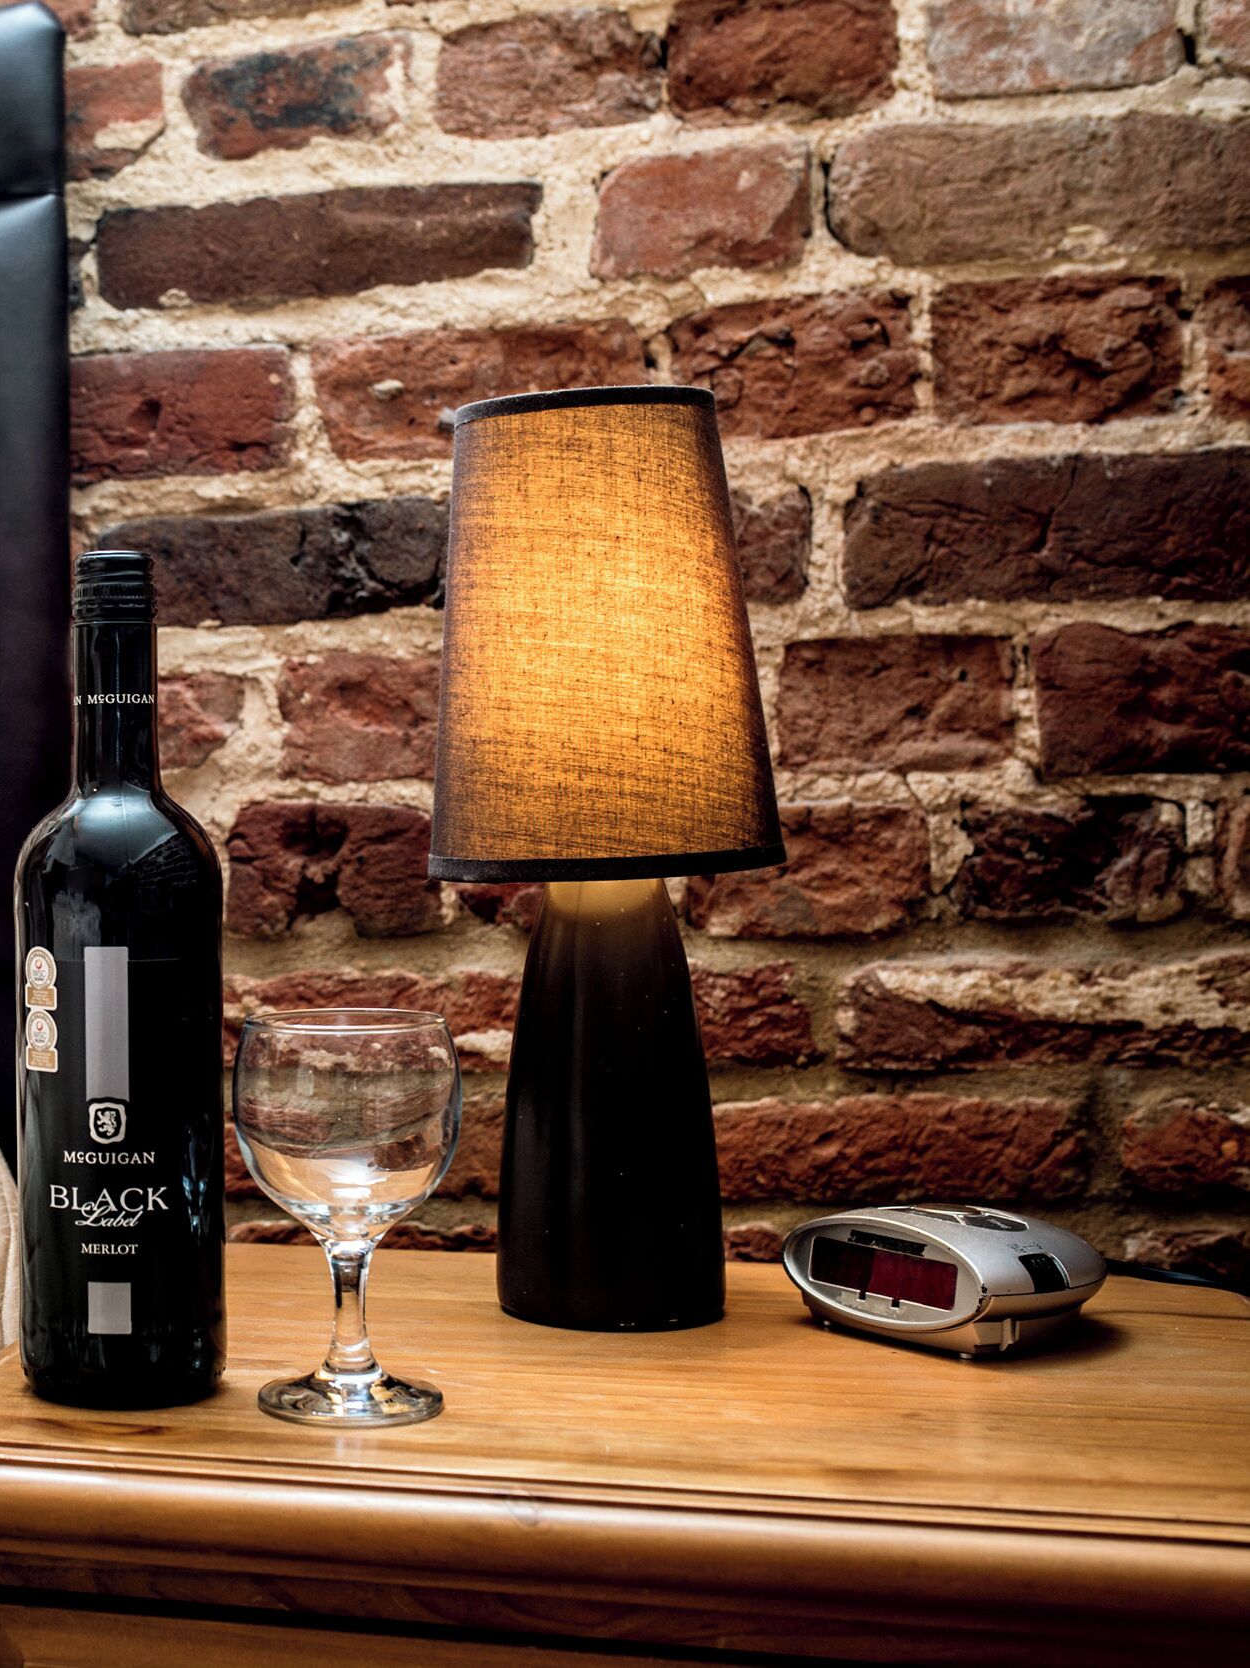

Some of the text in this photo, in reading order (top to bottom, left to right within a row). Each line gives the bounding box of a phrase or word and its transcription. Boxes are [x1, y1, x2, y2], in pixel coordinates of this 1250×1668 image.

[87, 693, 155, 705] McGUIGAN
[63, 1150, 156, 1165] McGUIGAN
[49, 1184, 170, 1212] BLACK
[74, 1201, 144, 1227] Label
[80, 1242, 138, 1255] MERLOT
